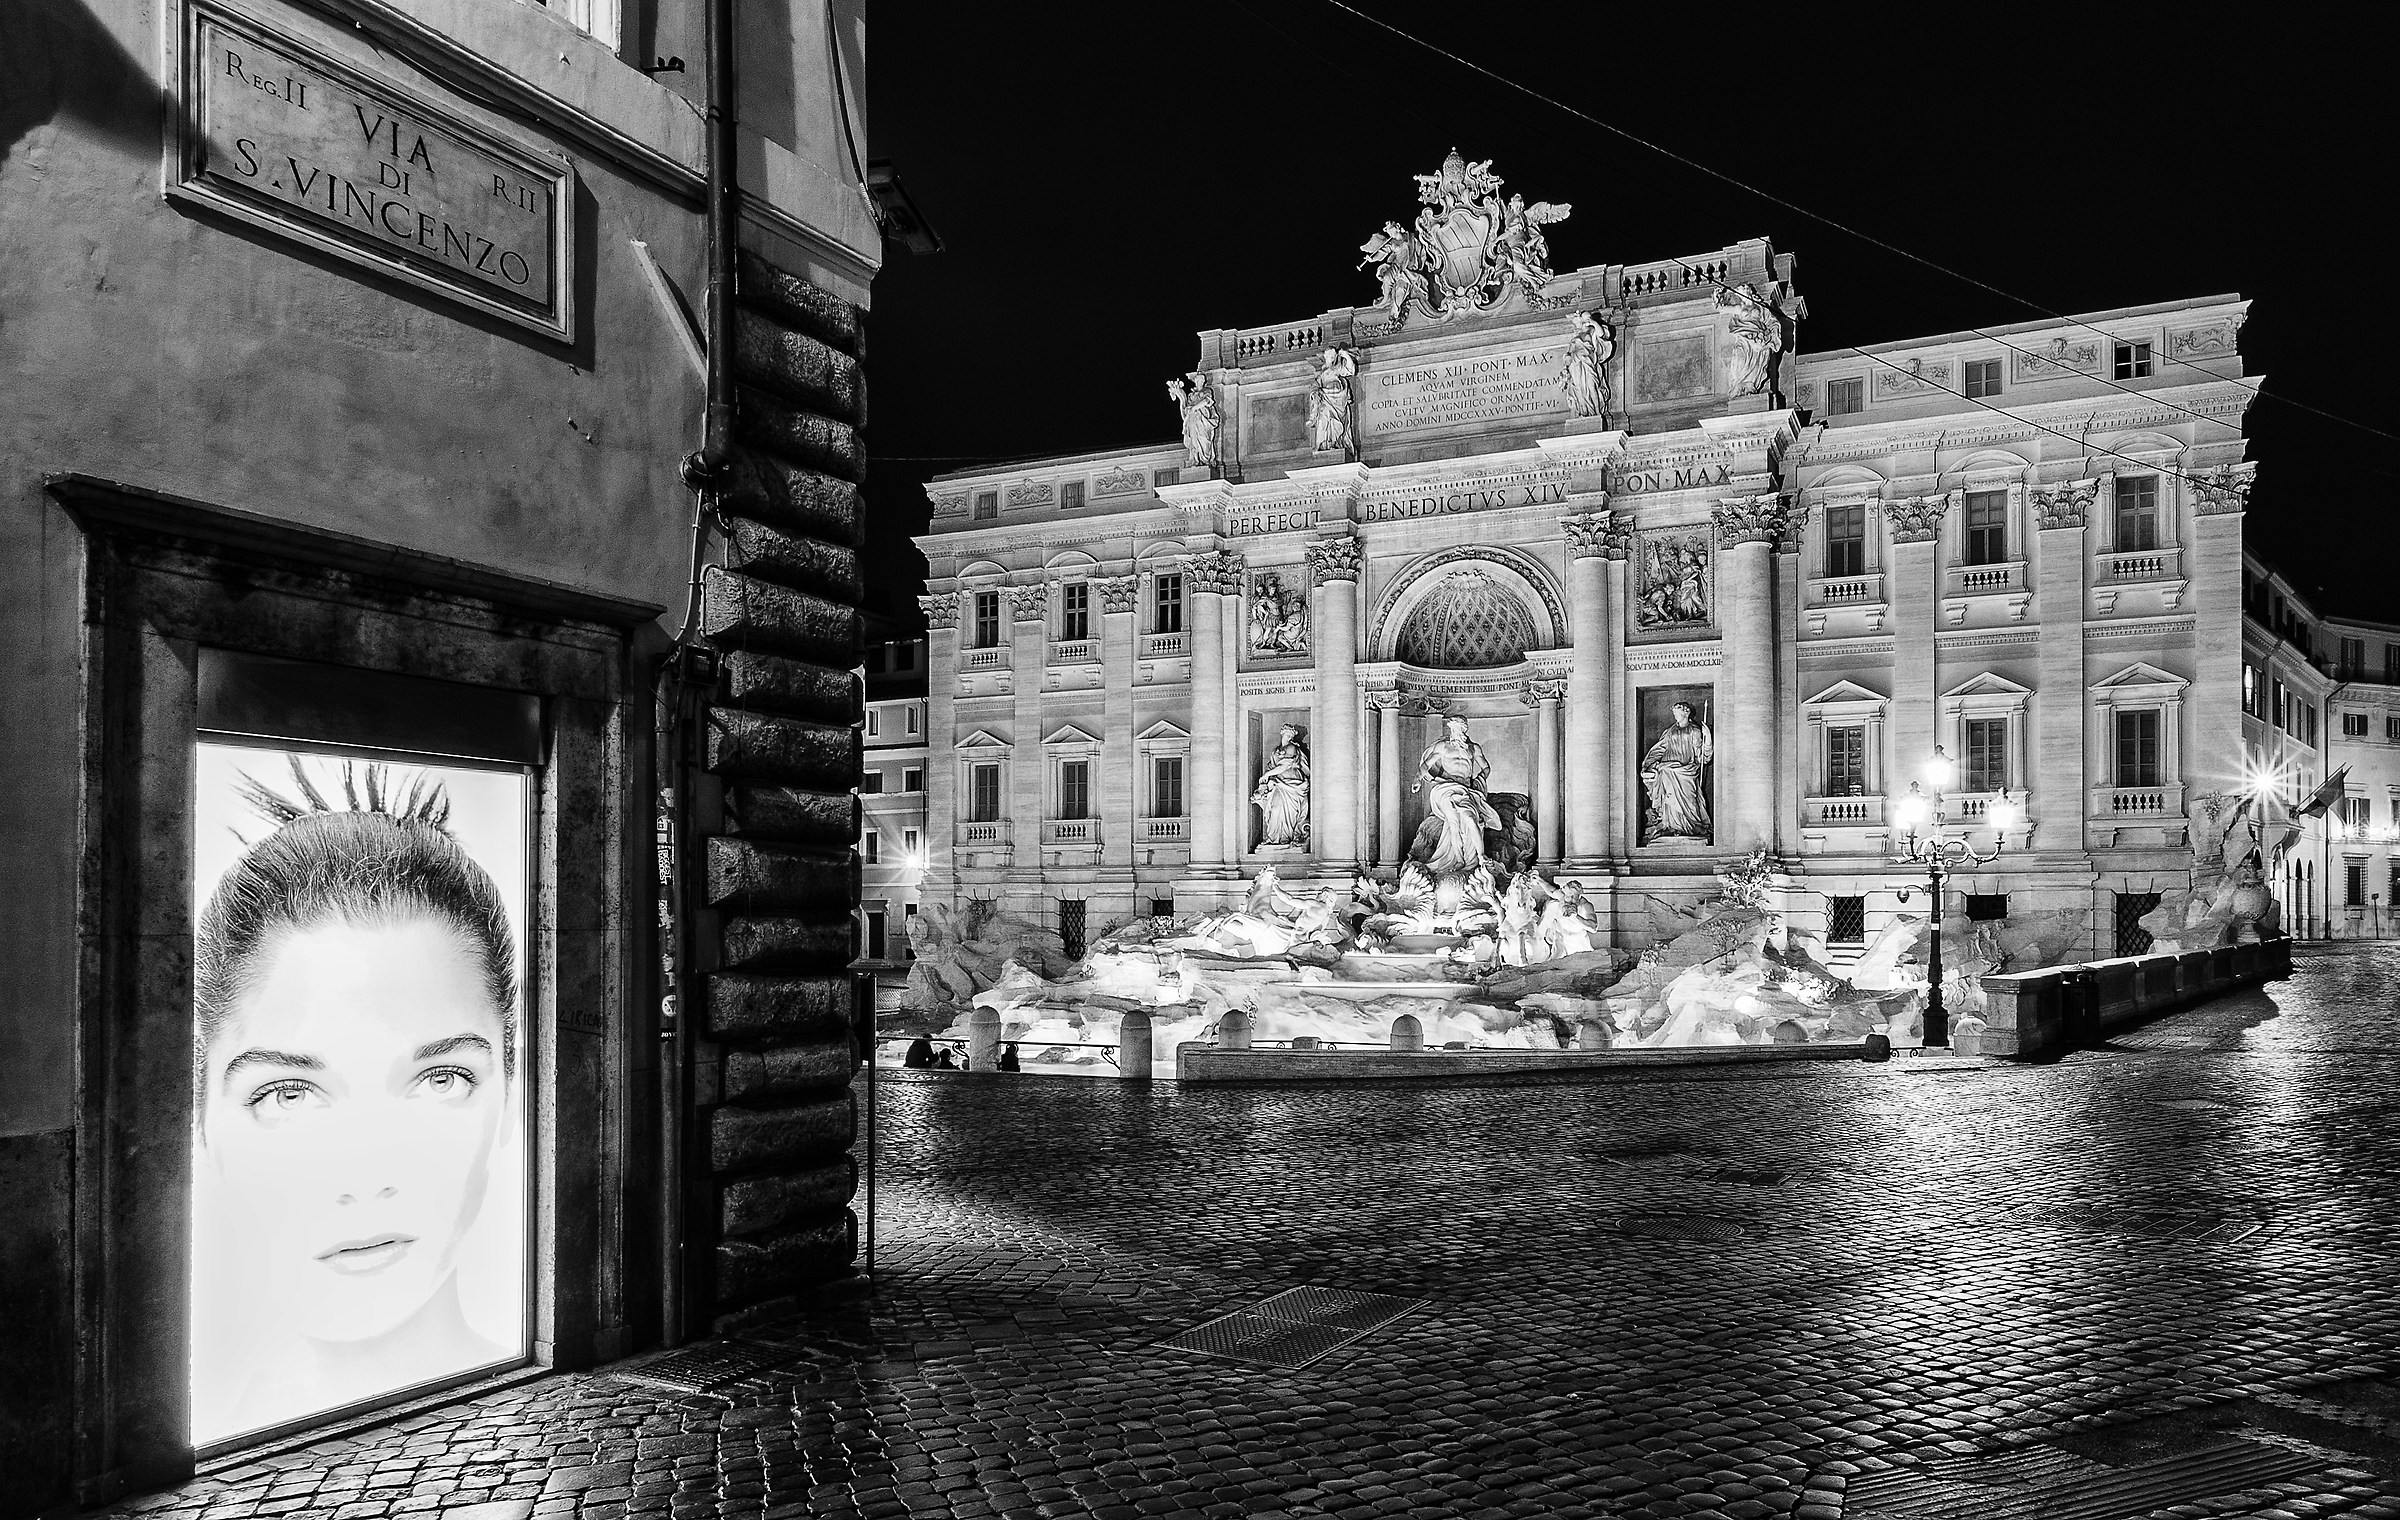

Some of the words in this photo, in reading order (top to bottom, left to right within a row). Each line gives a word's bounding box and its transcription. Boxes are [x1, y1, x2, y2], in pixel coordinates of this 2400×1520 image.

[353, 104, 434, 173] VIA
[379, 161, 411, 197] DI
[1381, 368, 1438, 387] CLEMENS
[1419, 380, 1454, 393] AQVAM
[1460, 372, 1510, 386] VIRGINEM
[1371, 399, 1399, 410] COPIA
[1402, 396, 1413, 406] ET
[1416, 388, 1477, 403] SALVBRITATE
[1482, 376, 1560, 395] COMMENDATAM
[1394, 405, 1425, 418] CVLTV
[1430, 397, 1486, 413] MAGNIFICO
[1490, 391, 1536, 405] ORNAVIT
[1375, 420, 1403, 431] ANNO
[1406, 415, 1441, 427] DOMINI
[1229, 510, 1320, 536] PERFECIT
[1365, 489, 1506, 522] BENEDICTVS
[1240, 688, 1263, 696] POSITIS
[1265, 686, 1286, 695] SIGNIS
